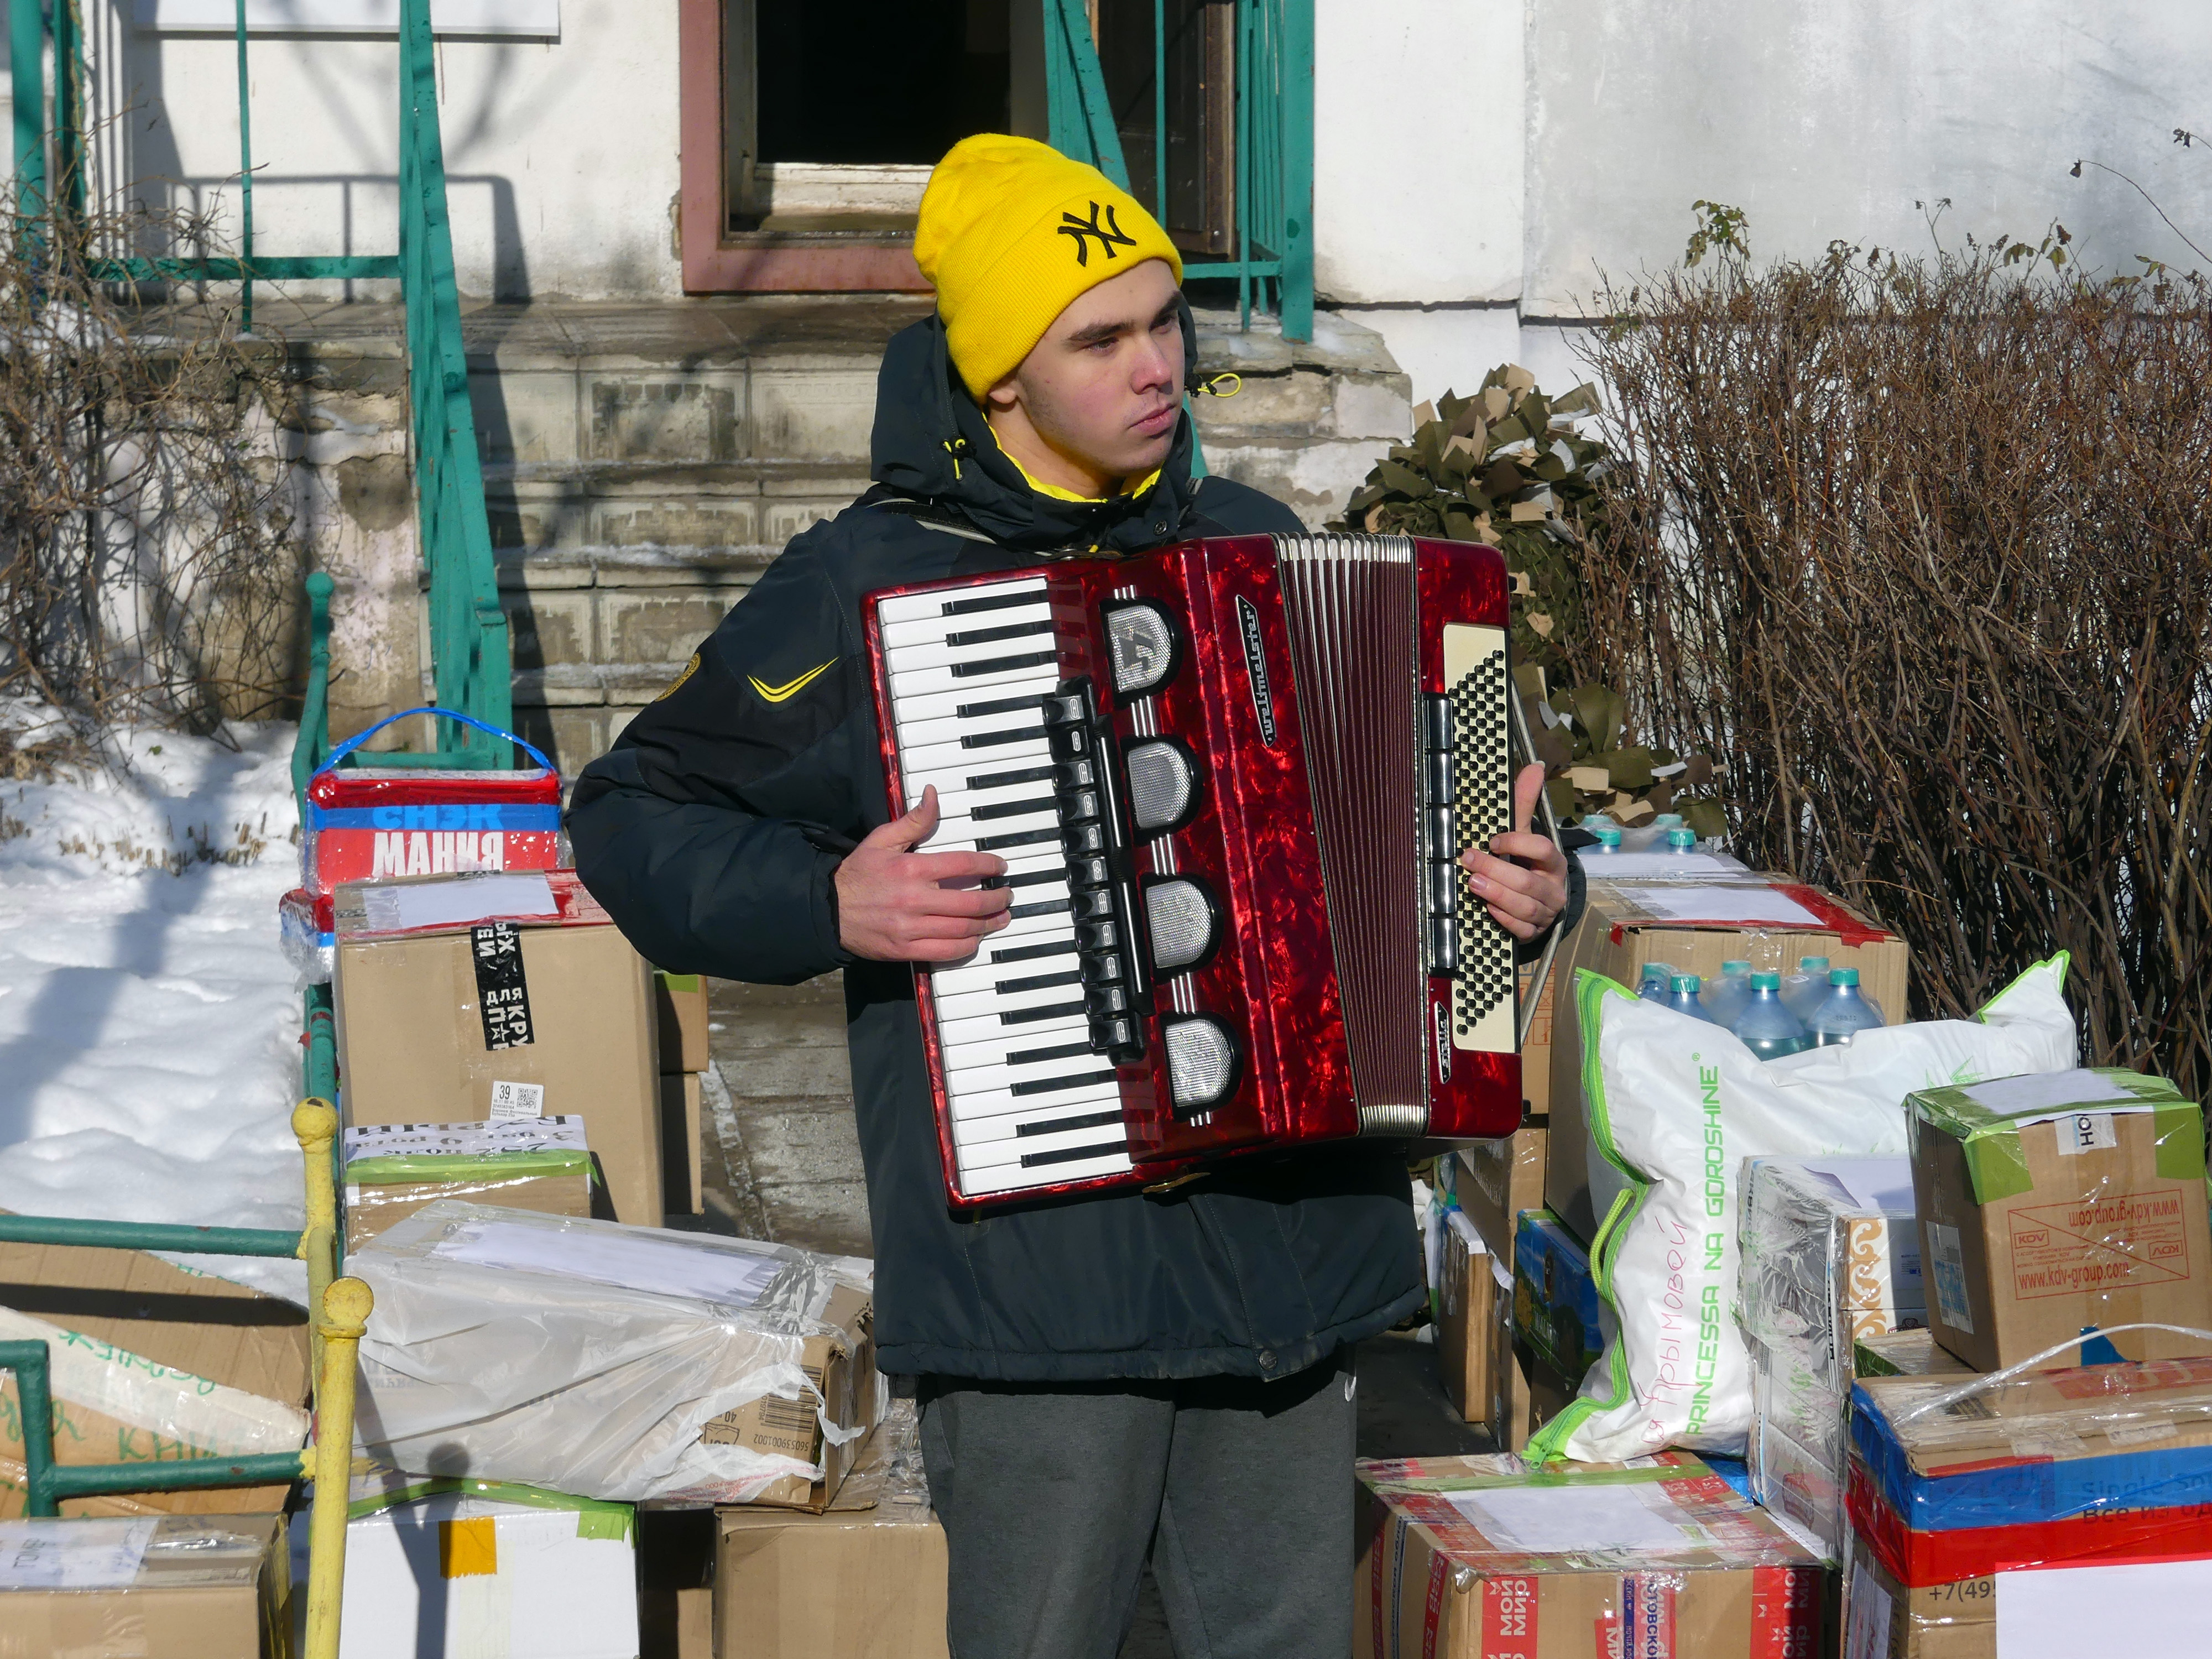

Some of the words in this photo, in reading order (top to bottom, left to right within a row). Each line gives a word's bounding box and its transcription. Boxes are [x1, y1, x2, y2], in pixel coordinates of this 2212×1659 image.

[1057, 200, 1136, 267] NY
[372, 832, 504, 877] МАНИЯ
[487, 987, 523, 1006] ДЛЯ
[499, 1084, 510, 1099] 39
[1699, 1065, 1725, 1217] GOROSHINE
[2068, 1200, 2179, 1227] www.kdv-group.com
[1702, 1234, 1723, 1271] NA
[2017, 1233, 2046, 1244] KDV
[2153, 1244, 2180, 1256] KDV
[2018, 1261, 2130, 1290] www.kdv-group.com
[1686, 1286, 1720, 1435] PRINCESSA
